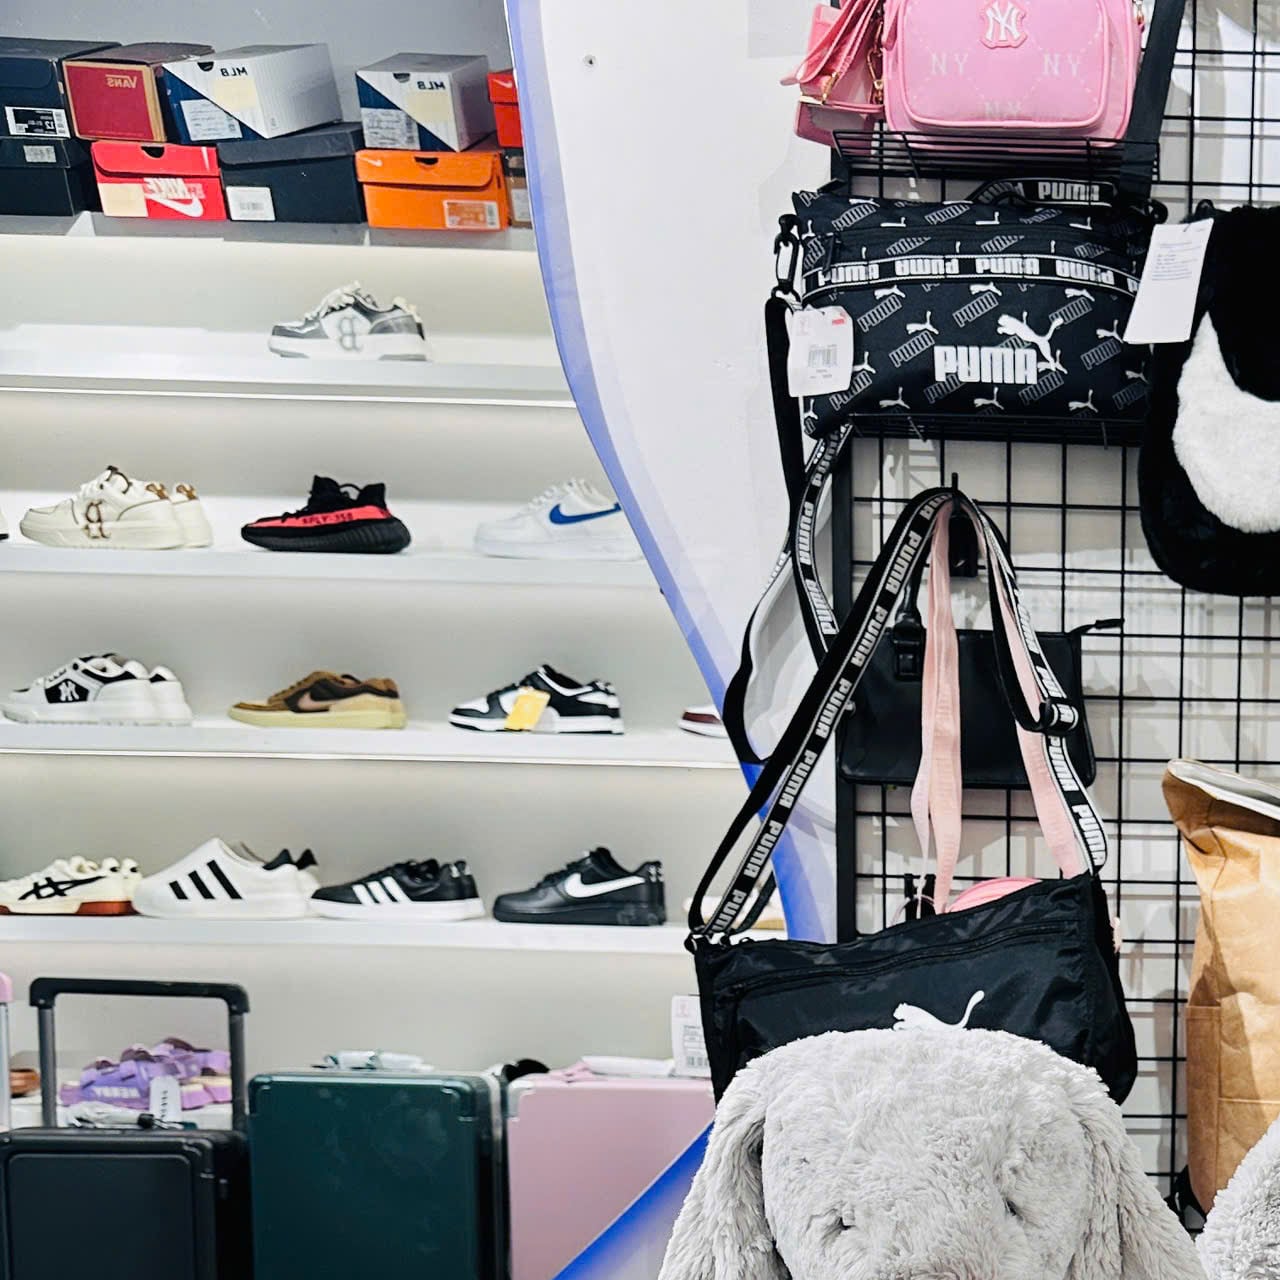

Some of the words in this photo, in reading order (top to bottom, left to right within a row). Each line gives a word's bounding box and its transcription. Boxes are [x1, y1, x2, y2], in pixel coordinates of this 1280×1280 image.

[985, 0, 1021, 41] NY
[1038, 181, 1100, 201] PUMA
[818, 263, 880, 287] PUMA
[895, 258, 960, 276] PUMA
[975, 257, 1040, 275] PUMA
[1055, 259, 1115, 285] PUMA
[857, 294, 903, 333] PUMA
[952, 291, 999, 328] PUMA
[889, 330, 936, 368] PUMA
[934, 345, 1038, 385] PUMA
[798, 500, 815, 566] PUMA
[885, 529, 923, 596] PUMA
[805, 578, 839, 635] PUMA
[851, 604, 889, 668] PUMA
[815, 677, 853, 739] PUMA
[778, 749, 819, 809] PUMA
[1048, 734, 1080, 792] PUMA
[743, 819, 784, 879] PUMA
[1071, 804, 1107, 867] PUMA
[711, 888, 748, 932] PUM
